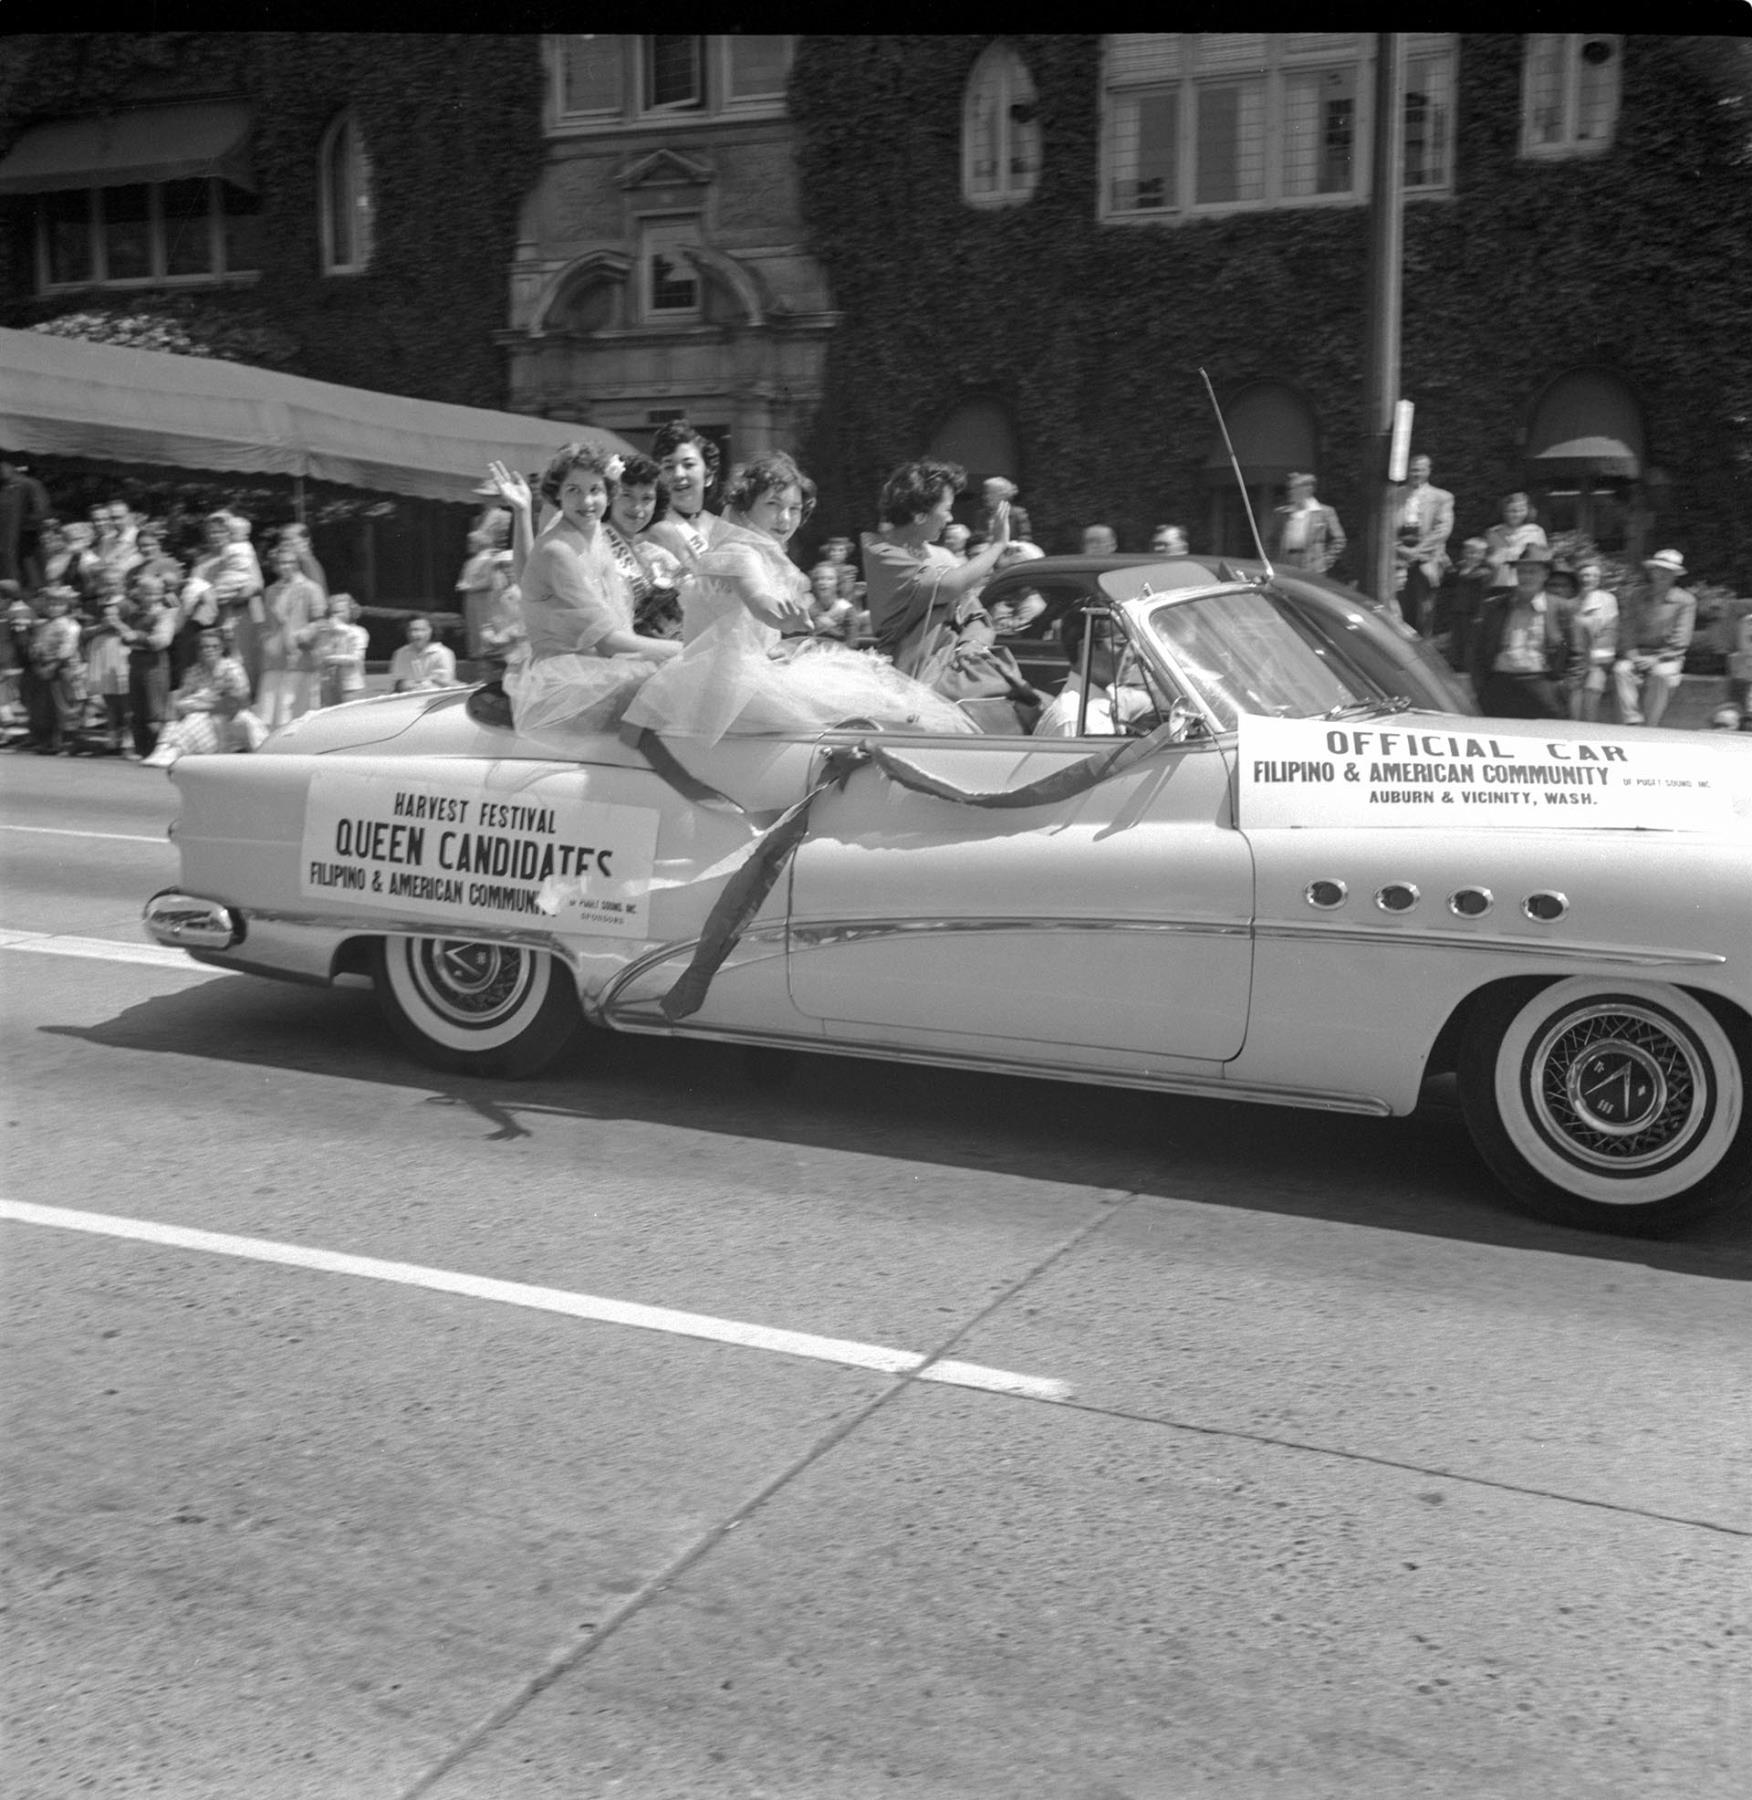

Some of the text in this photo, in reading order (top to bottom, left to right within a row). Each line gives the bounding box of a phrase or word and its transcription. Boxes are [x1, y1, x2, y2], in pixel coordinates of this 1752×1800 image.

[1326, 730, 1629, 763] OFFICIAL CAR
[1253, 760, 1335, 784] FILIPINO
[1343, 762, 1362, 784] &
[1369, 762, 1476, 784] AMERICAN
[1482, 764, 1610, 787] COMMUNITY
[394, 792, 556, 834] HARVEST FESTIVAL
[1369, 790, 1598, 808] AUBURN & VICINITY, WASH.
[336, 819, 613, 881] QUEEN CANDIDATES
[311, 861, 366, 890] FILIPINO
[371, 869, 384, 893] &
[389, 872, 463, 903] AMERICAN
